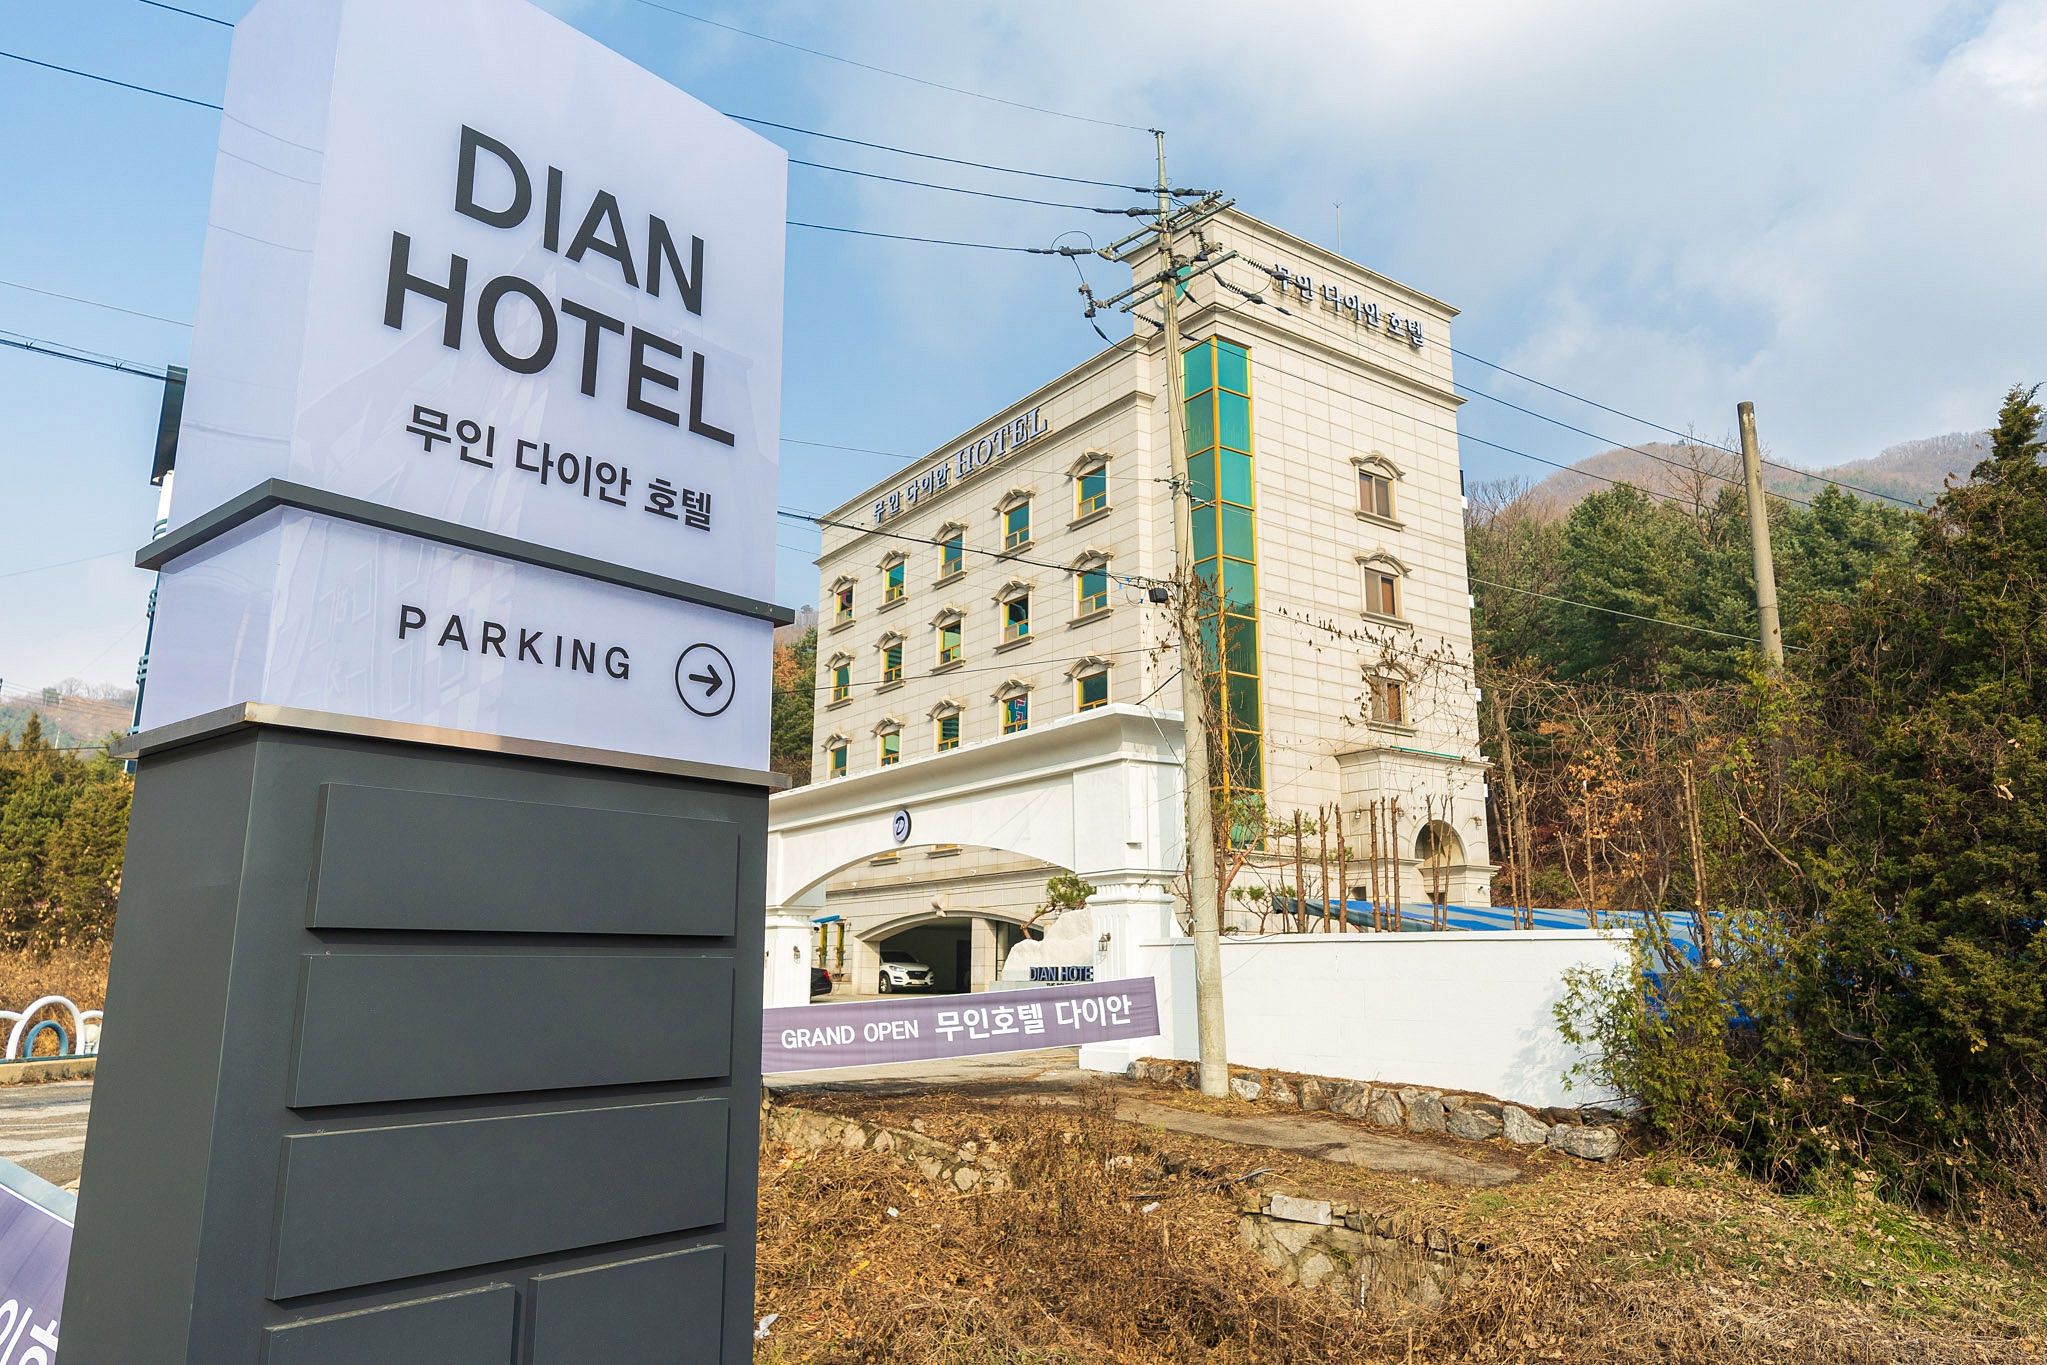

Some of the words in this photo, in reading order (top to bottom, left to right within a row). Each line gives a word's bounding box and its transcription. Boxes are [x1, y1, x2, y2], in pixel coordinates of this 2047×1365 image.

[454, 124, 704, 316] DIAN
[383, 230, 735, 447] HOTEL
[1322, 284, 1382, 328] 다이안
[1387, 312, 1424, 347] 호텔
[406, 404, 495, 469] 무인
[515, 439, 632, 507] 다이안
[644, 477, 712, 532] 호텔
[873, 490, 900, 523] 무인
[906, 462, 951, 503] 다이안
[955, 407, 1048, 480] HOTEL
[398, 604, 630, 680] PARKING
[780, 1025, 856, 1049] GRAND
[863, 1019, 919, 1043] OPEN
[934, 1002, 1046, 1042] 무인호텔
[1055, 994, 1133, 1029] 다이안
[1029, 966, 1059, 981] DIAN
